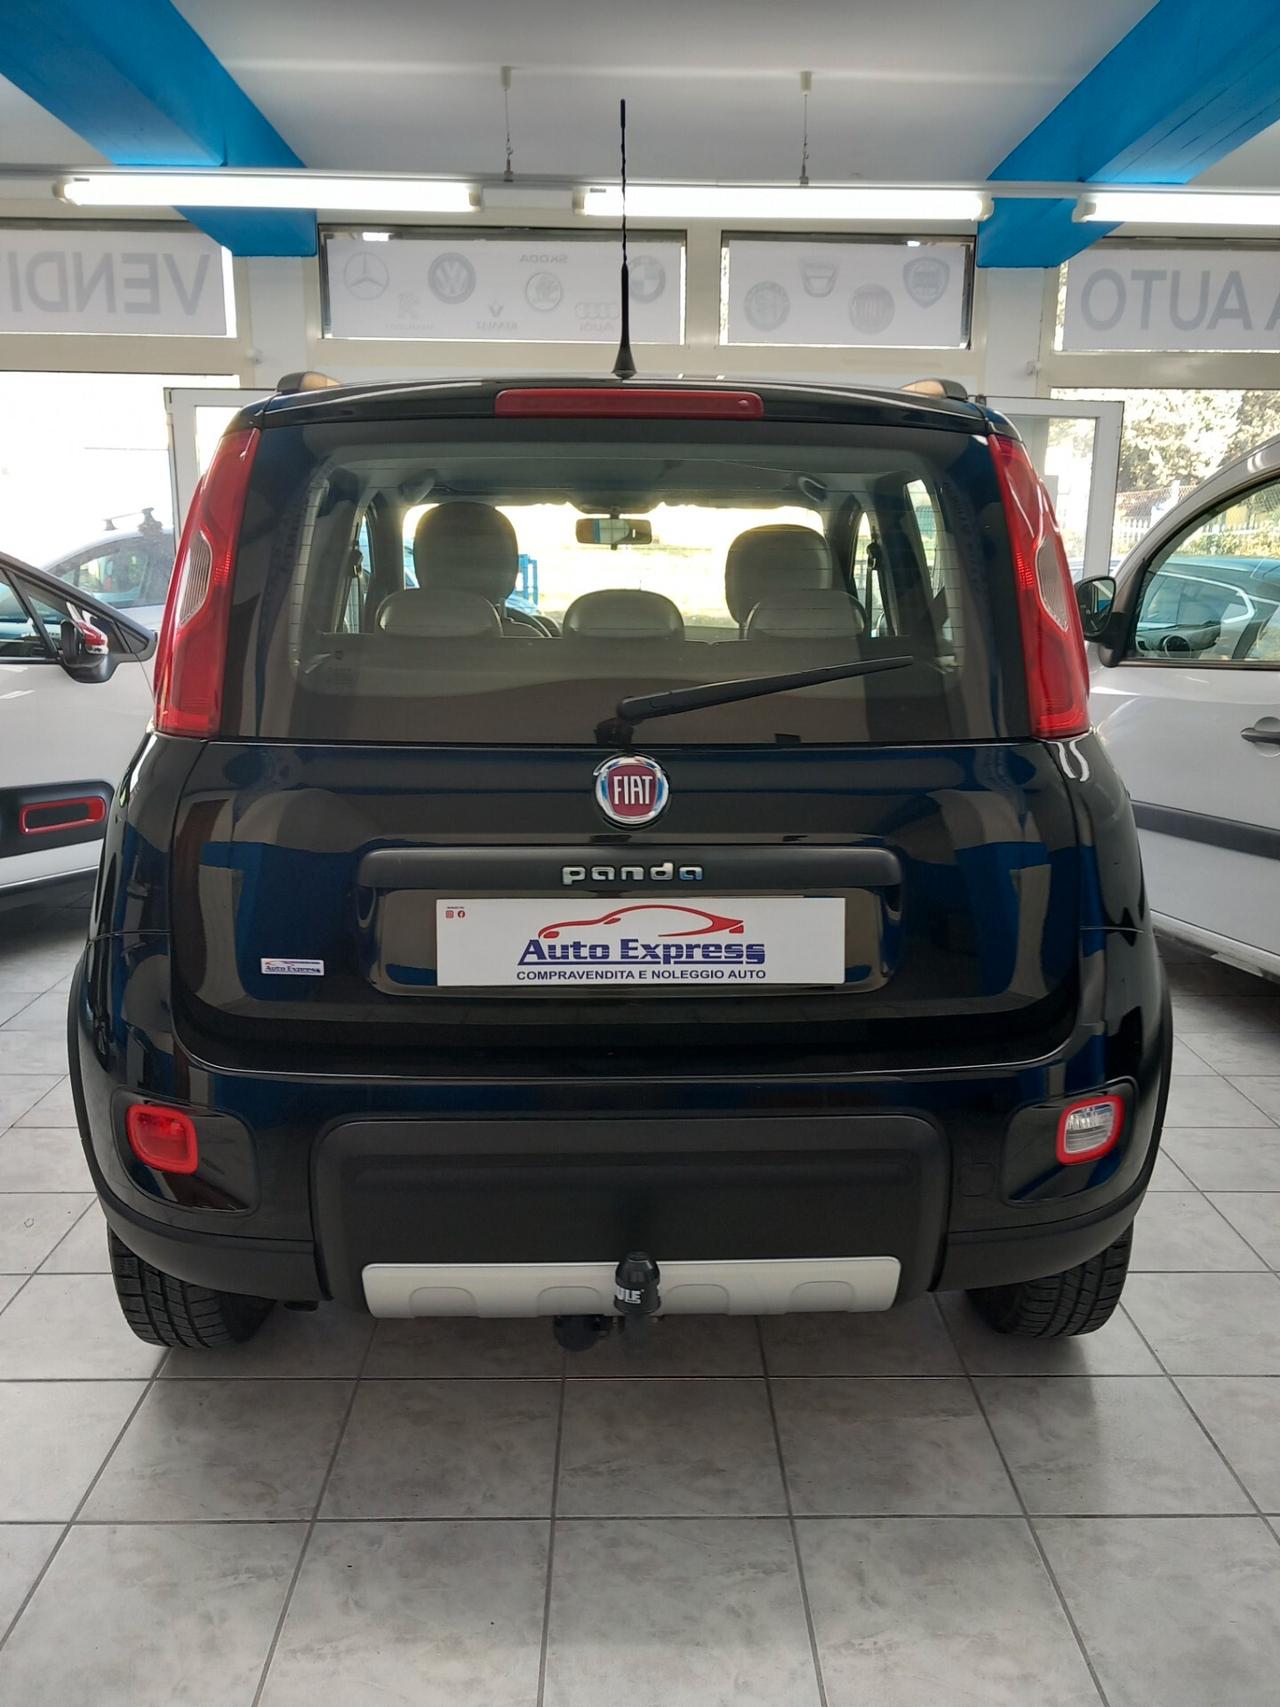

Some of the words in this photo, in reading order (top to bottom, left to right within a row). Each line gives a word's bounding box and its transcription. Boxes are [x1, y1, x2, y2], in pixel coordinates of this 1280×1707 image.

[613, 775, 654, 805] FIAT
[561, 862, 705, 885] panda
[517, 938, 611, 966] Auto
[619, 937, 766, 966] Express
[516, 970, 635, 981] COMPRAVENDITA
[638, 970, 648, 980] E
[651, 969, 725, 980] NOLEGGIO
[728, 969, 766, 980] AUTO
